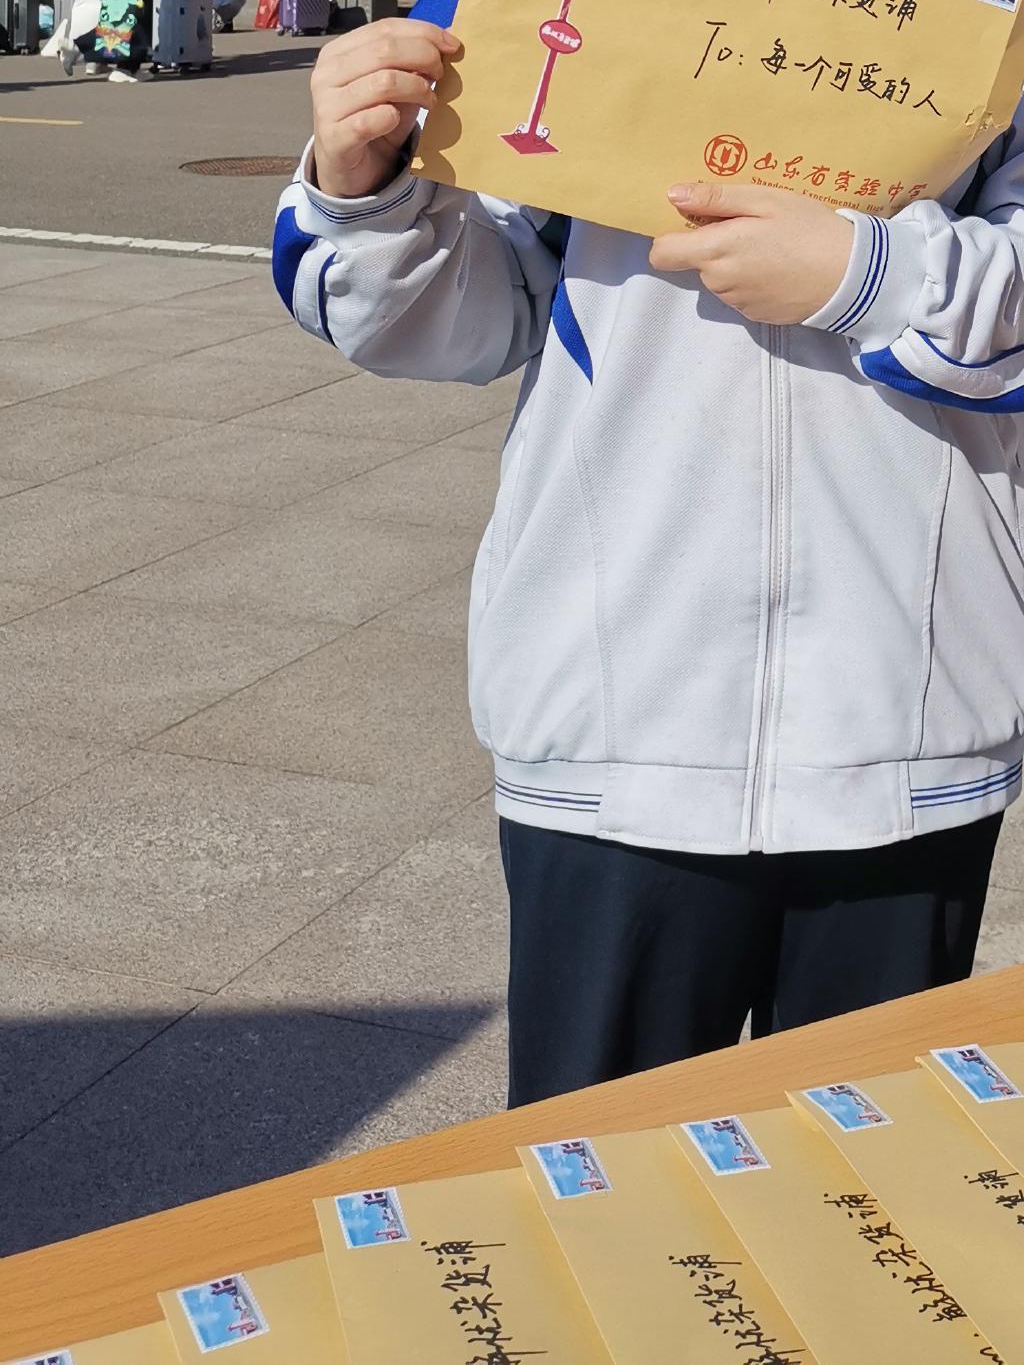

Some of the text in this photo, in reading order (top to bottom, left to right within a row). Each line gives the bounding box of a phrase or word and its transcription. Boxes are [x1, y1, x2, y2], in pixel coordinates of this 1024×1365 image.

[760, 38, 943, 116] 每一个可爱的人
[753, 151, 928, 204] 山东省实验中学
